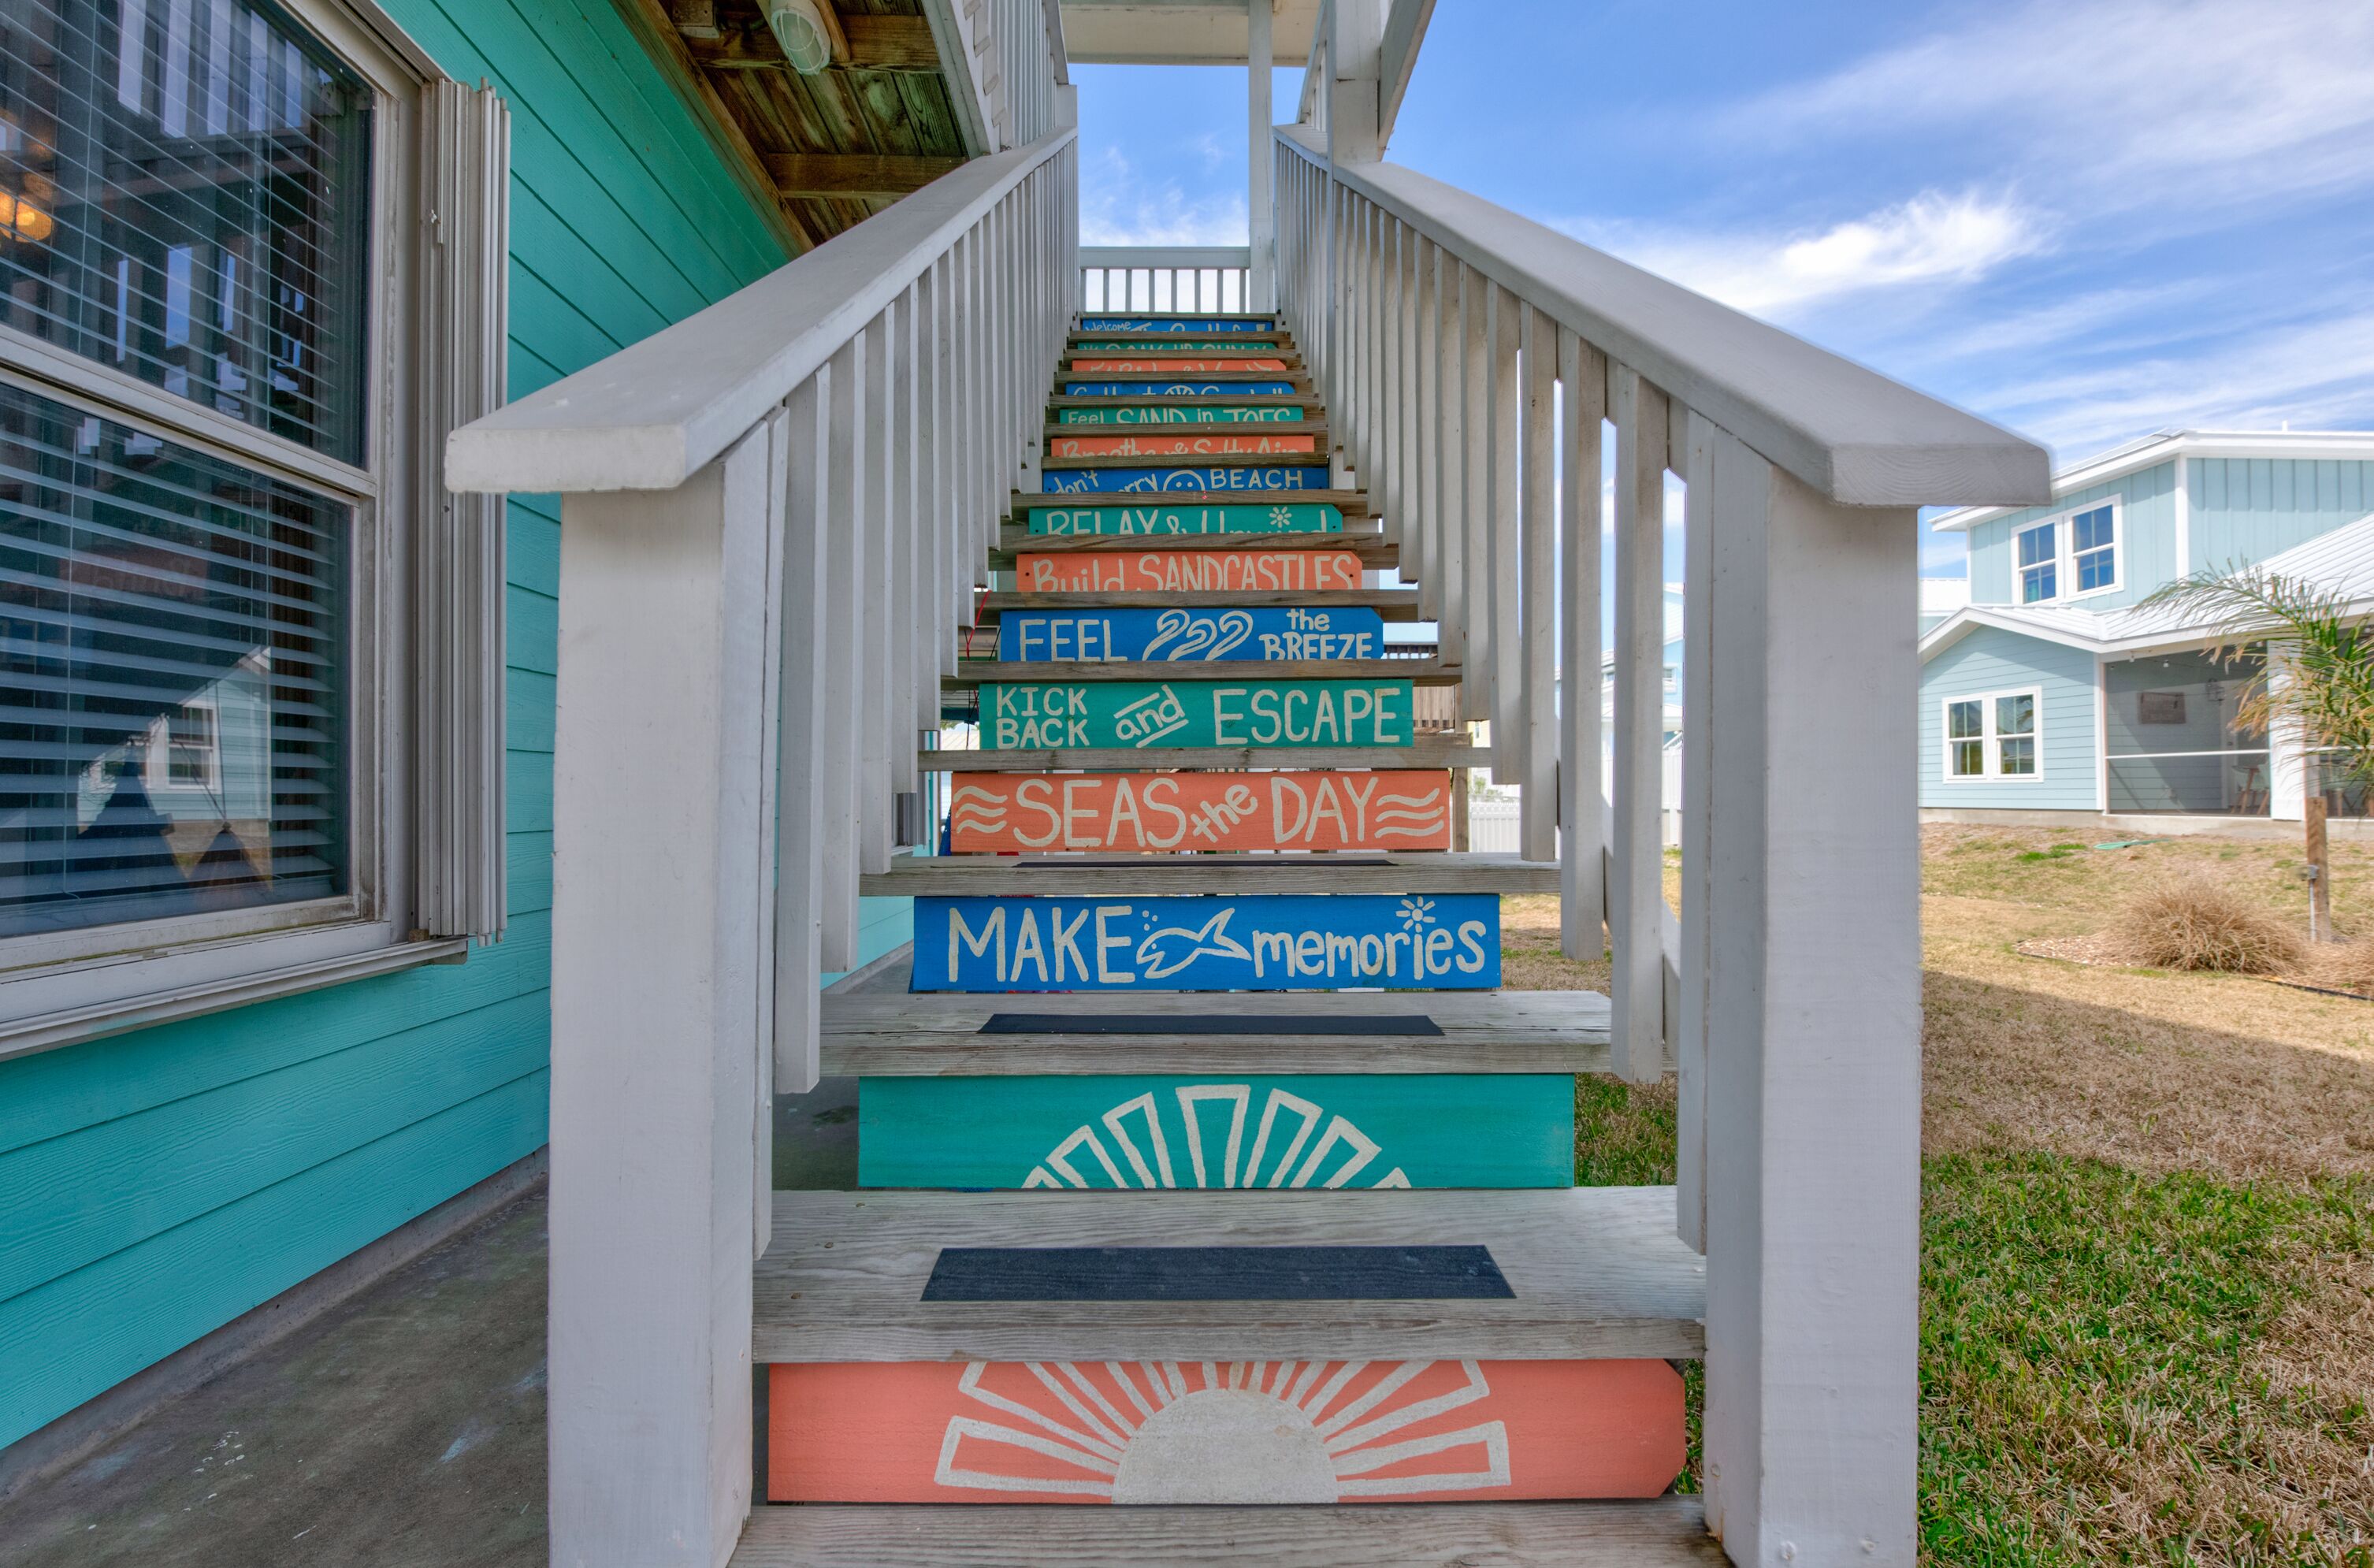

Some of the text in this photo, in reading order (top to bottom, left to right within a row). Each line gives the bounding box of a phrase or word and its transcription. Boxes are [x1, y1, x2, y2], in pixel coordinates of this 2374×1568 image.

[1068, 411, 1104, 423] Feel
[1198, 407, 1214, 423] in
[1053, 470, 1098, 492] don't
[1209, 469, 1303, 489] BEACH
[1032, 554, 1354, 592] Build SANDCASTLES
[1286, 608, 1330, 631] the
[1019, 619, 1128, 661] FEEL
[1258, 631, 1373, 660] BREEZE
[996, 686, 1088, 716] KICK
[1114, 684, 1401, 745] and ESCAPE
[996, 717, 1090, 749] BACK
[1012, 776, 1379, 848] SEAS the DAY
[948, 905, 1487, 983] MAKE memories
